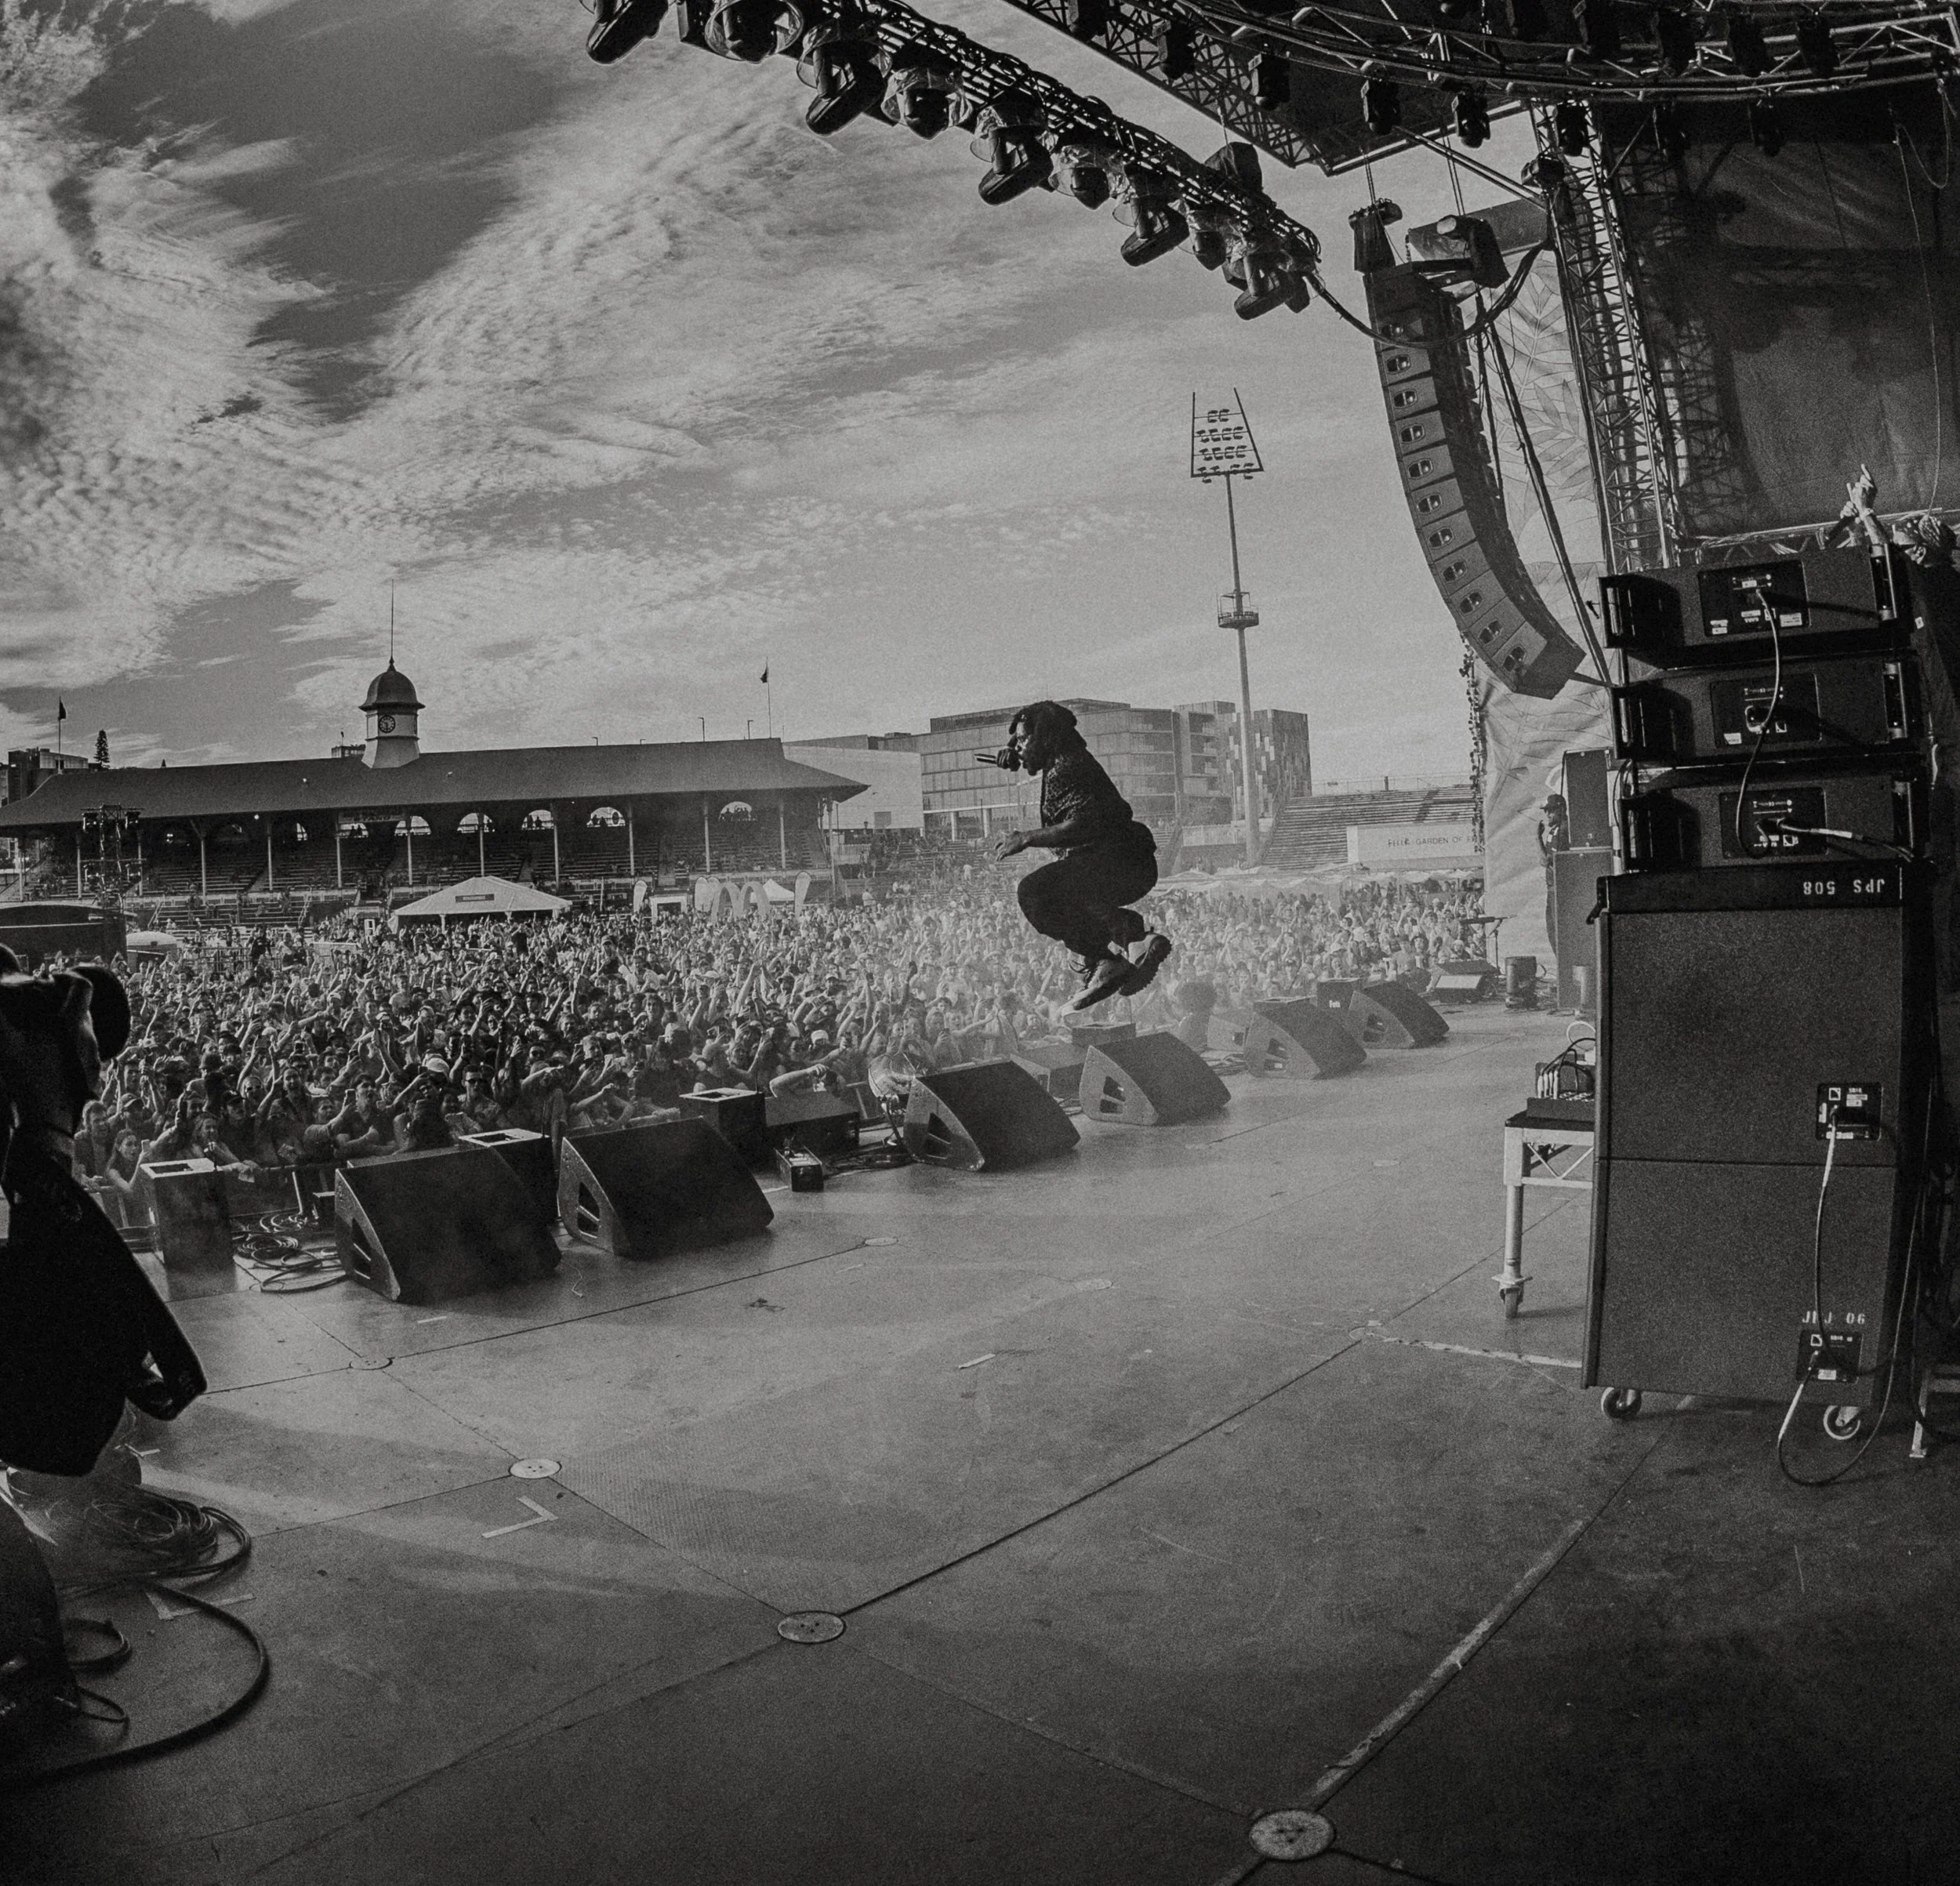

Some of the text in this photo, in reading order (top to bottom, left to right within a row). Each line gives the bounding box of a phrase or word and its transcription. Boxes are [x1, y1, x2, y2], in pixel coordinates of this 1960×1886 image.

[1803, 878, 1885, 894] JPS 508
[1846, 1312, 1865, 1324] 06
